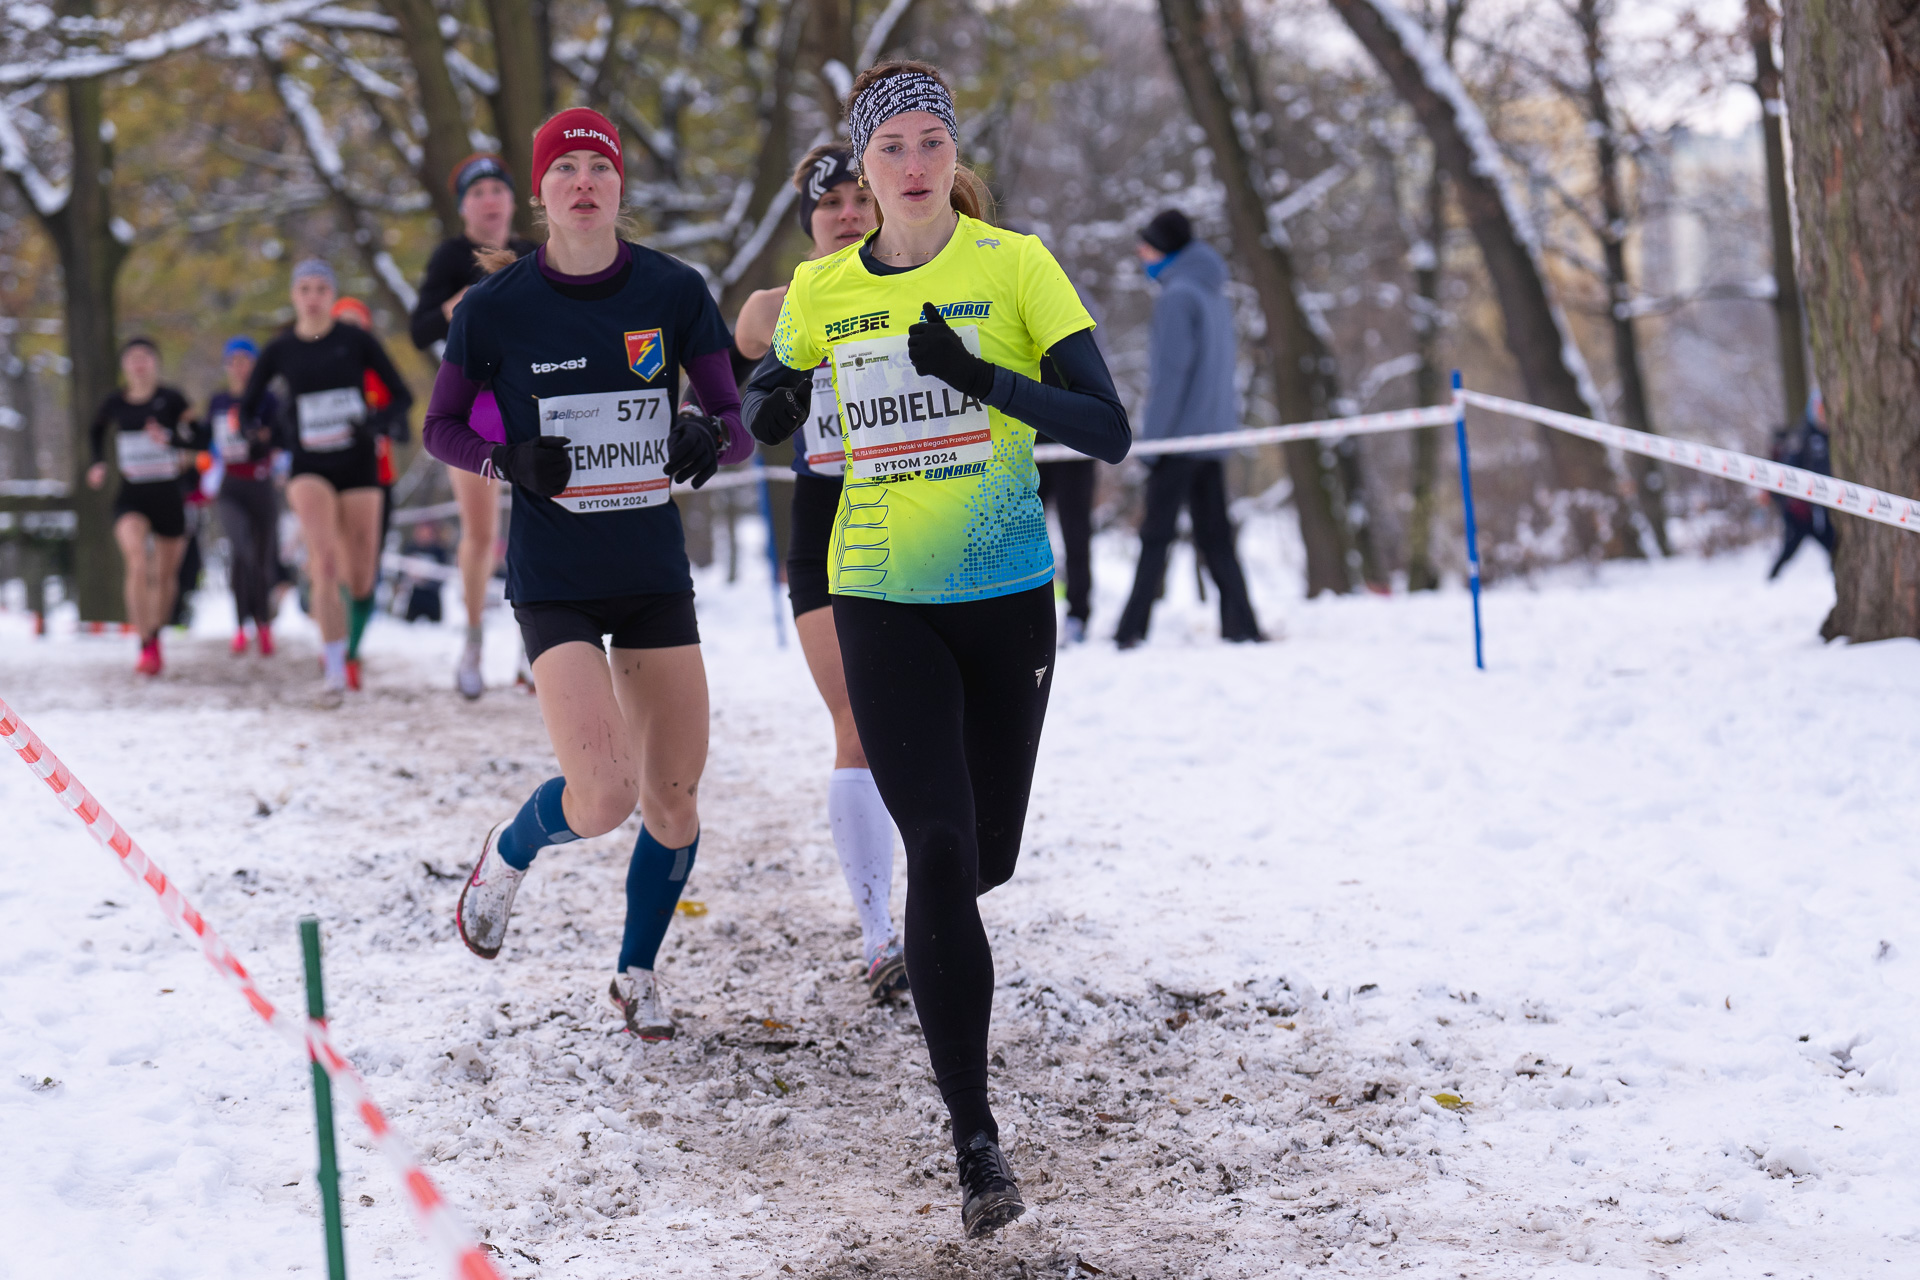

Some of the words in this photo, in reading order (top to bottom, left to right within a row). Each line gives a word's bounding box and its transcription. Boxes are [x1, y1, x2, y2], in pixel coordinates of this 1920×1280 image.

[546, 407, 600, 421] Bellsport
[617, 398, 660, 422] 577
[846, 389, 982, 430] DUBIELLA
[563, 438, 666, 472] TEMPNIAK
[874, 458, 920, 472] BYTOM
[924, 452, 958, 466] 2024
[924, 462, 987, 480] SONAROL
[579, 498, 620, 510] BYTOM
[622, 496, 648, 506] 2024
